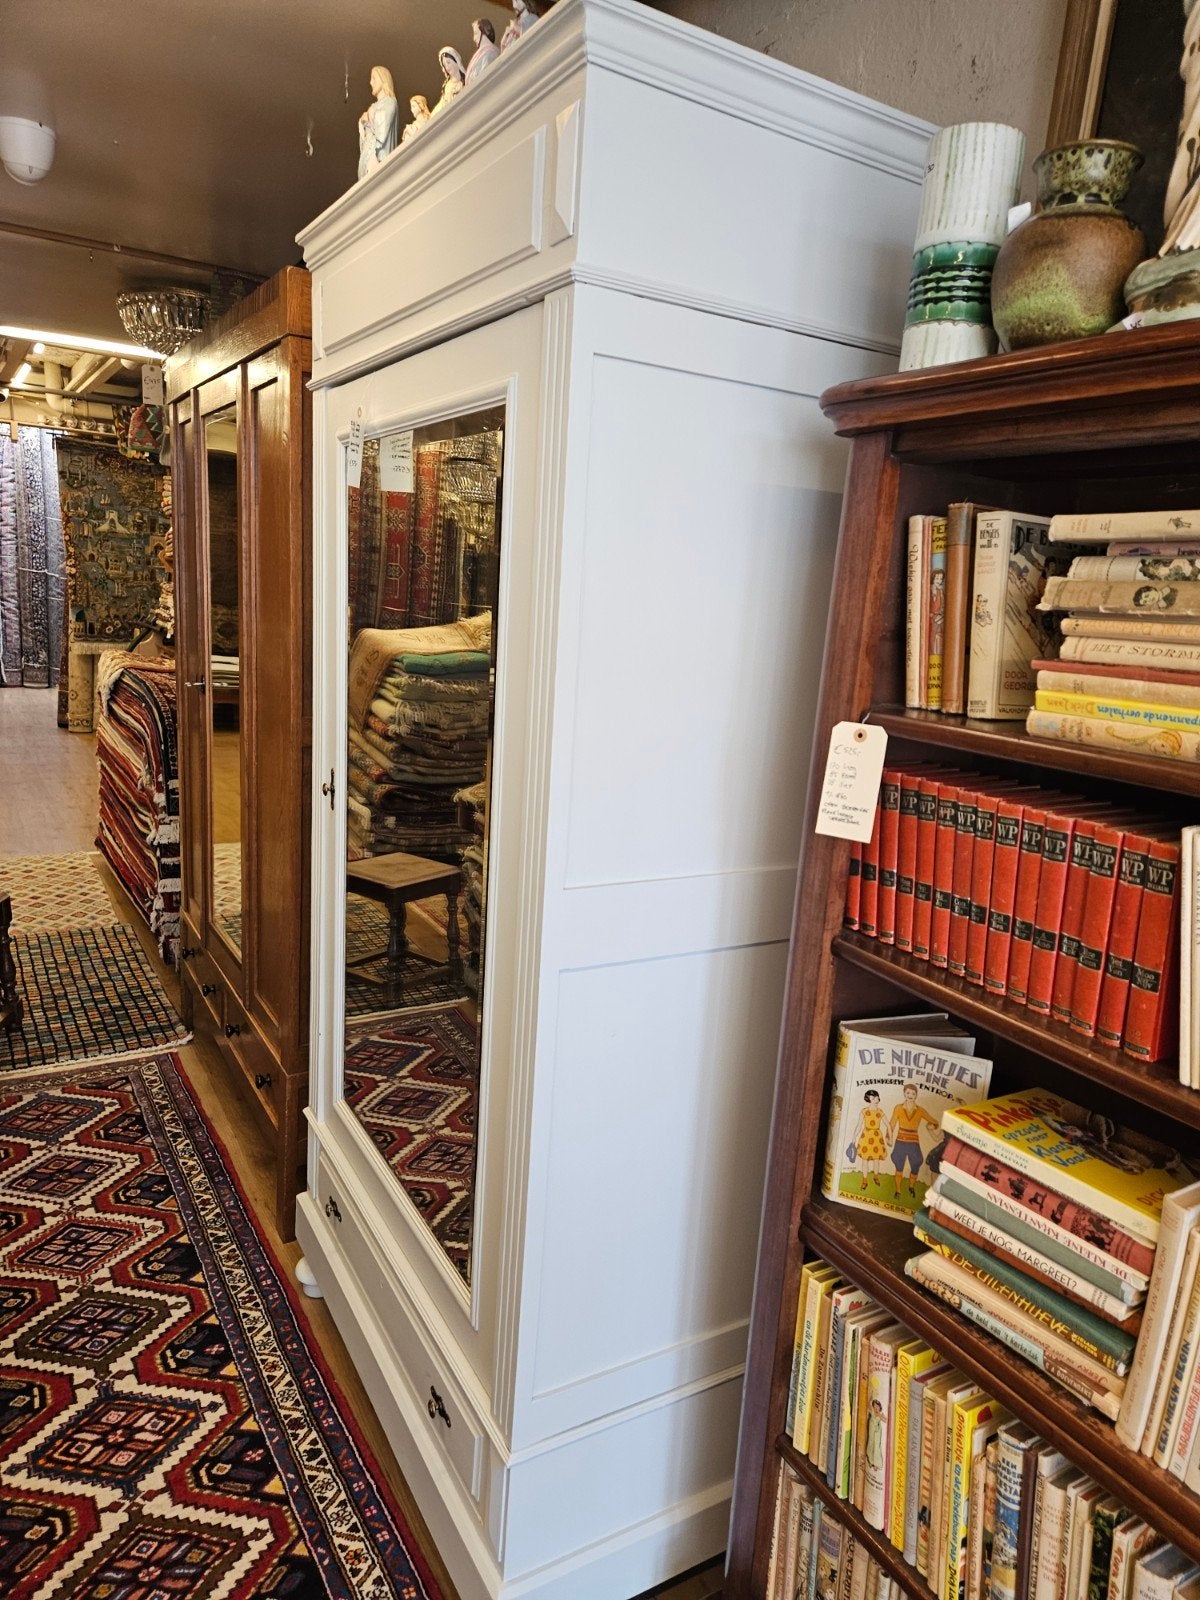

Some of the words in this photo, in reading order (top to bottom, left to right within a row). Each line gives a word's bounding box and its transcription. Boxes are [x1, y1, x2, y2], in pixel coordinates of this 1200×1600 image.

[1092, 643, 1126, 652] HET
[1096, 704, 1141, 720] verhalen
[957, 812, 976, 826] WP
[997, 822, 1018, 839] WP
[1022, 829, 1041, 845] WP
[1045, 837, 1067, 853] WP
[1093, 850, 1115, 868] WP
[1122, 858, 1144, 876] WP
[1148, 866, 1173, 886] WP
[858, 1049, 885, 1065] DE
[890, 1048, 983, 1090] NICHTJES
[887, 1065, 914, 1079] JET
[924, 1072, 950, 1089] INE
[839, 1191, 880, 1208] ALKMAAR
[952, 1209, 977, 1231] WEET
[976, 1223, 989, 1237] JE
[1016, 1247, 1079, 1290] MARGREET?
[1063, 1236, 1108, 1268] KLEINE
[952, 1253, 974, 1273] DE
[1111, 1267, 1128, 1281] DE
[1148, 1293, 1158, 1312] VAN
[965, 1308, 975, 1317] de
[989, 1325, 1002, 1335] van
[1173, 1339, 1192, 1382] BEGIN
[1163, 1382, 1182, 1425] NIEUW
[1156, 1426, 1171, 1453] EEN
[954, 1464, 961, 1476] en
[953, 1476, 961, 1489] de
[947, 1565, 957, 1585] Dick
